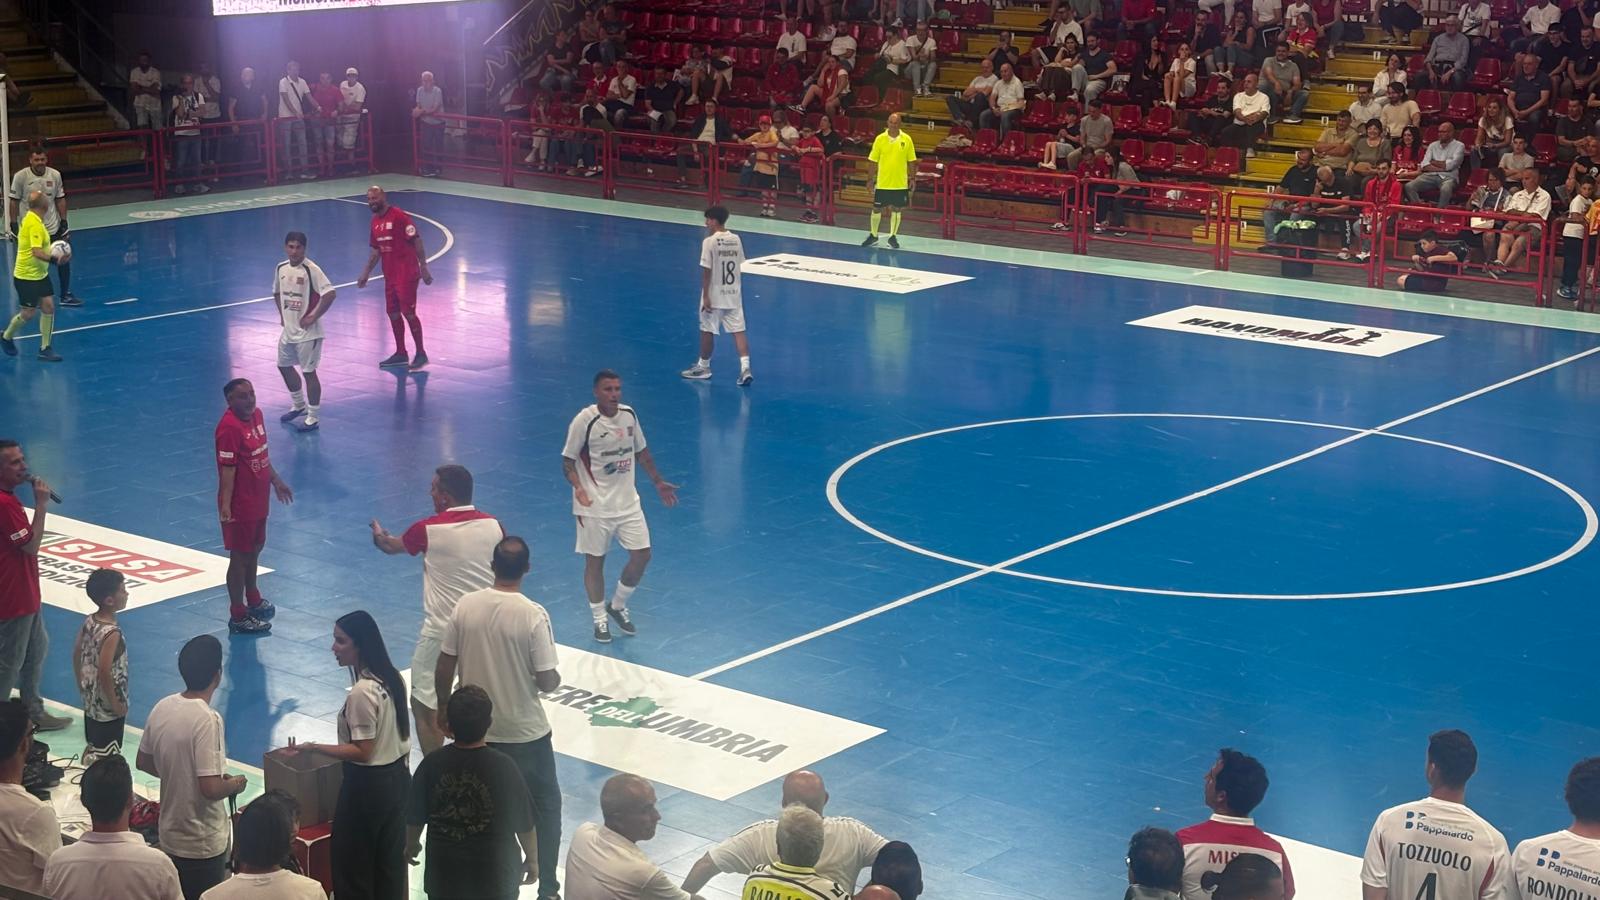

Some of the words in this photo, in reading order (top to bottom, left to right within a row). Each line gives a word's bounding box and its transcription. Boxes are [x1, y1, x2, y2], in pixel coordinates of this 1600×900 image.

[722, 260, 736, 286] 18
[1179, 317, 1371, 347] HANDMADE
[47, 543, 193, 581] SUSA
[641, 711, 789, 763] UMBRIA
[1398, 842, 1472, 872] TOZZUOLO
